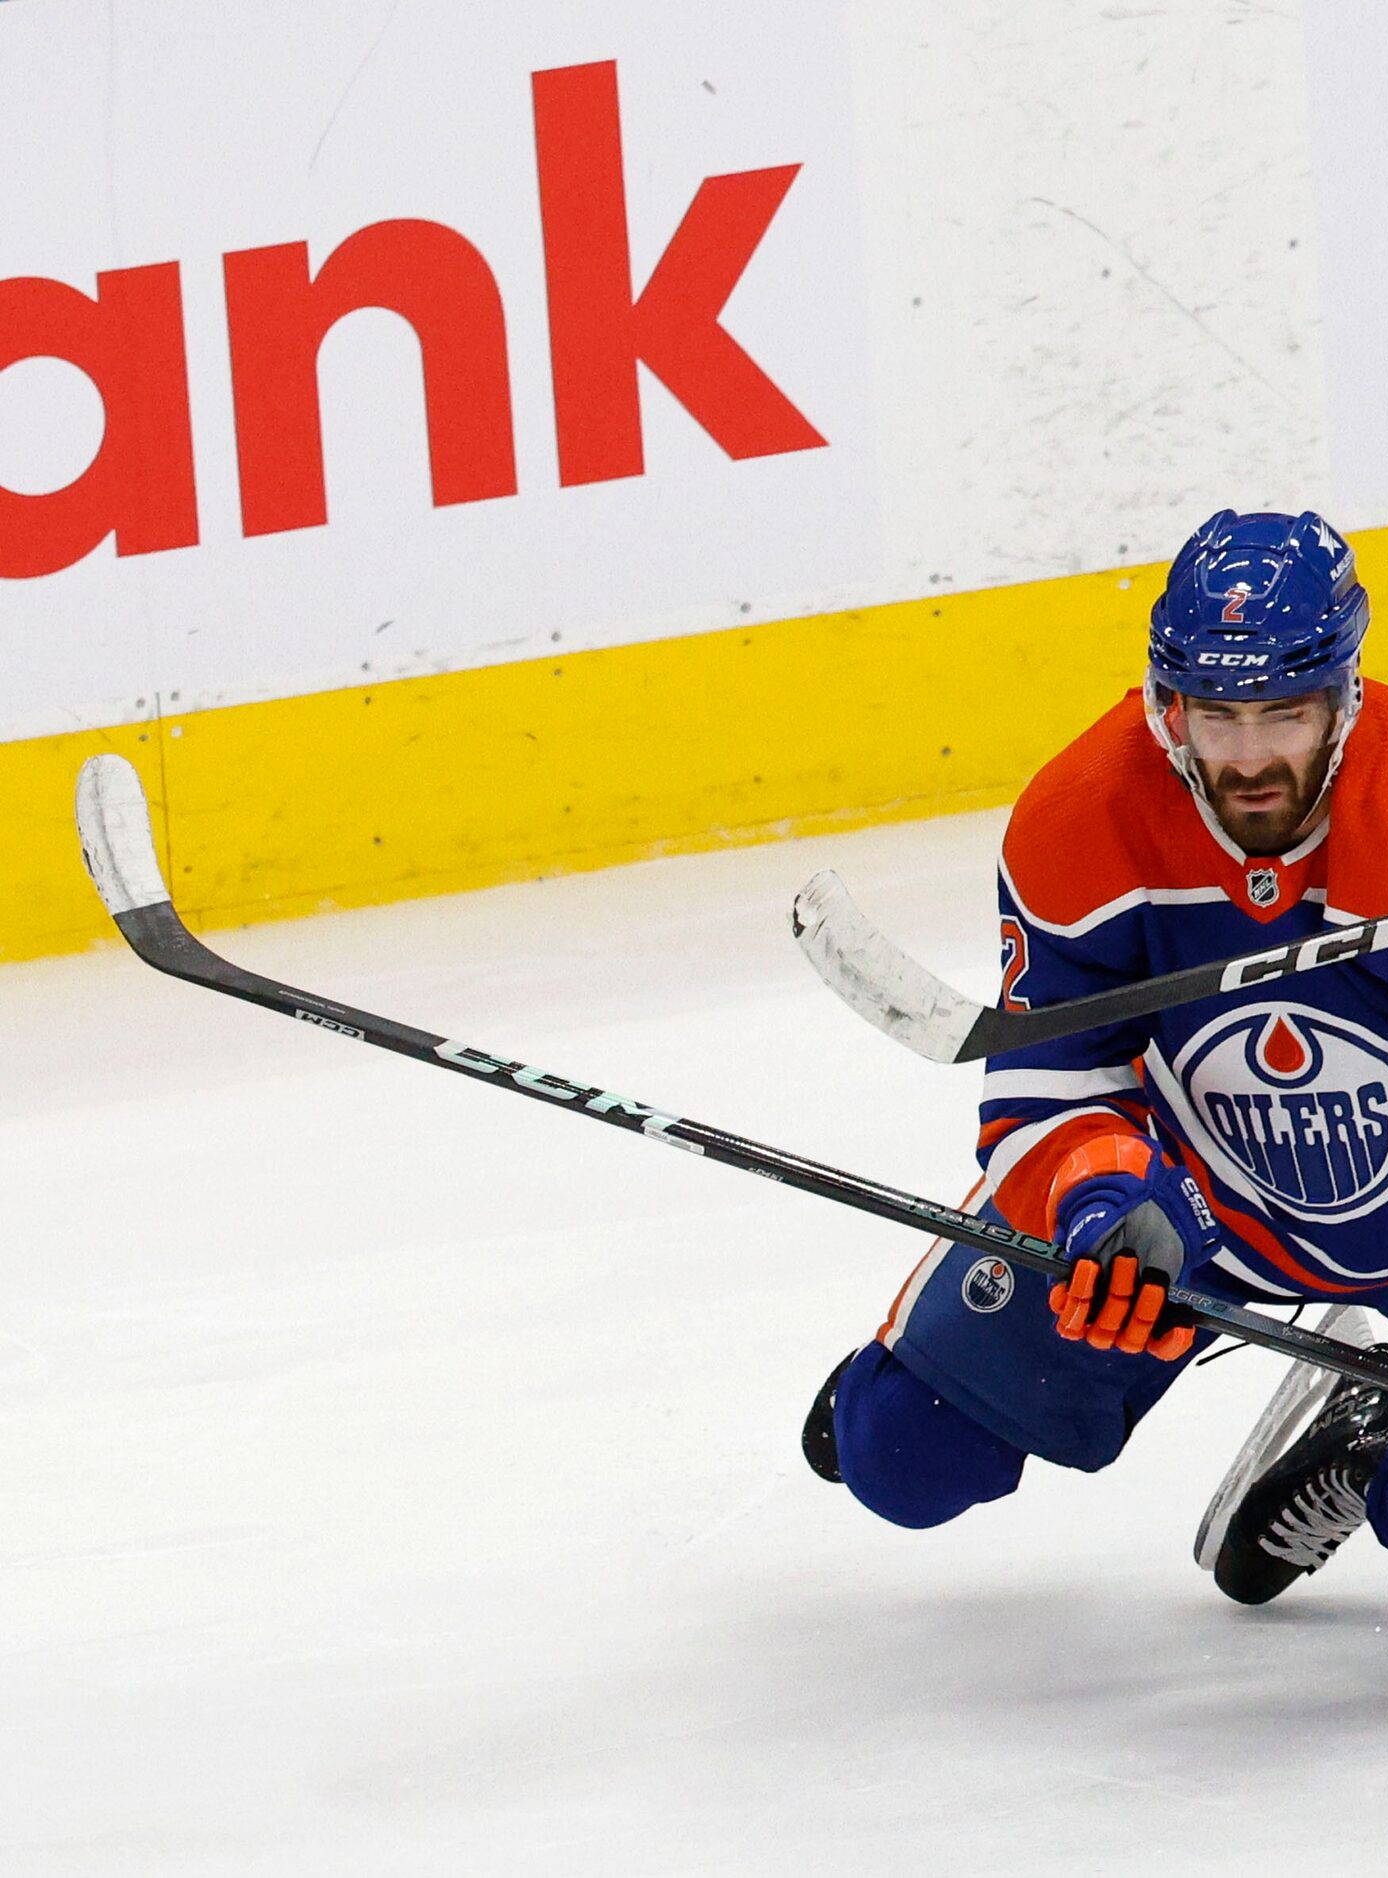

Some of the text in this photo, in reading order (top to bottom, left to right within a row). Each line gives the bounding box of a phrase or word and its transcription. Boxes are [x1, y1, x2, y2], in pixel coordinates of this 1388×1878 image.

[1221, 588, 1248, 623] 2
[1198, 653, 1269, 667] CCM
[1000, 914, 1031, 1012] 2
[433, 1039, 684, 1130] CCM
[1183, 1177, 1216, 1228] CCM
